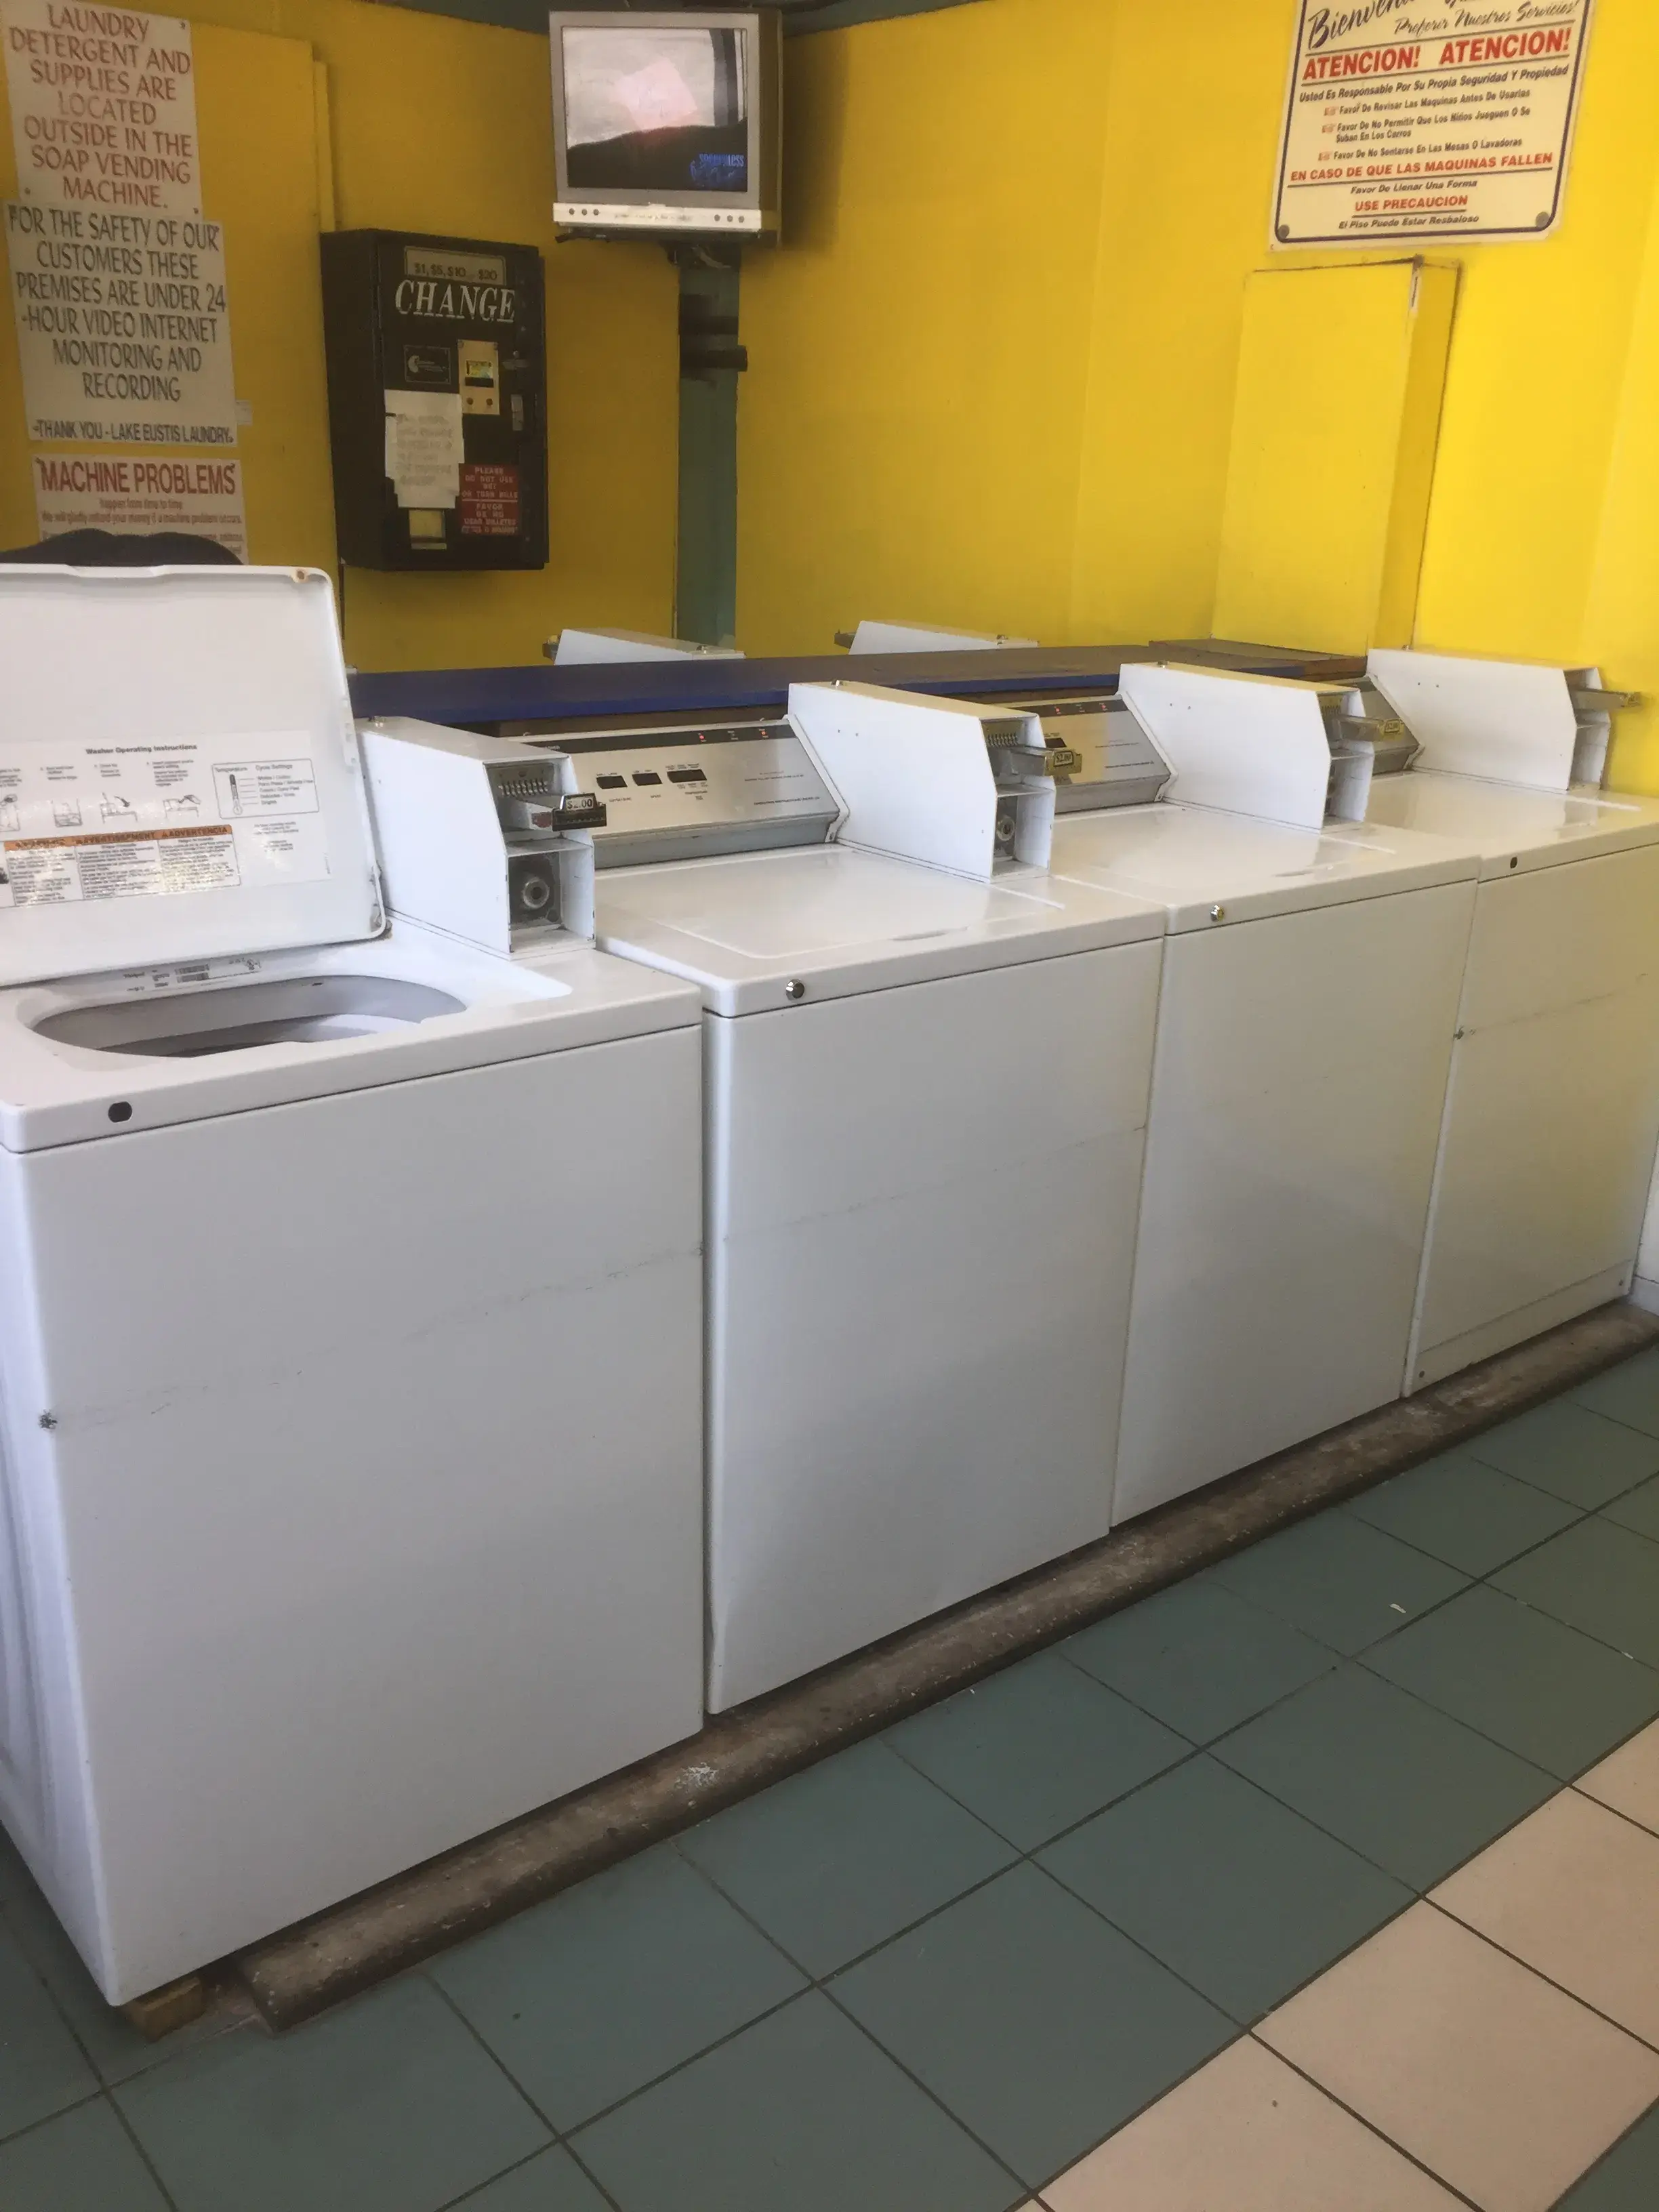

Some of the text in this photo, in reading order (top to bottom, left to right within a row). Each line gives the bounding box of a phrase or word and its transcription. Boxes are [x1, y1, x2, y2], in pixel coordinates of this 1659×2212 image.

[47, 4, 149, 42] LAUNDRY
[1455, 8, 1511, 27] Nuestros
[9, 26, 190, 75] DETERGENT AND
[1302, 27, 1572, 80] ATENCION! ATENCION!
[30, 59, 176, 100] SUPPLIES ARE
[1300, 64, 1569, 102] Usted Es Responsable Por Su Propia Seguridad Y Propiedad
[58, 90, 157, 125] LOCATED
[1337, 122, 1357, 131] Favor
[1359, 121, 1370, 130] De
[1372, 119, 1382, 129] No
[1384, 117, 1414, 127] Permitir
[1416, 115, 1431, 125] Que
[1434, 115, 1448, 123] Los
[1511, 107, 1518, 117] O
[1520, 106, 1531, 116] Se
[1339, 89, 1530, 115] Favor De Revisar Las Maquinas Antes De Usarlas
[24, 115, 192, 157] OUTSIDE IN THE
[1334, 138, 1522, 160] Favor De No Sentarse En Las Mesas O Lavadoras
[1336, 129, 1412, 144] Suban En Los Carros
[32, 144, 191, 184] SOAP VENDING
[1290, 152, 1553, 182] EN CASO DE QUE LAS MAQUINAS FALLEN
[63, 176, 168, 209] MACHINE.
[1350, 185, 1376, 194] Favor
[1378, 184, 1391, 192] De
[1425, 181, 1443, 190] Una
[1446, 180, 1478, 188] Forma
[1355, 194, 1468, 211] USE PRECAUCION
[7, 205, 220, 251] FOR THE SAFETY OF OUR
[1338, 215, 1479, 229] El Piso Puede Estar Resbaloso
[37, 241, 199, 280] CUSTOMERS THESE
[18, 272, 226, 313] PREMISES ARE UNDER 24
[395, 279, 515, 323] CHANGE
[83, 310, 136, 337] VIDEO
[141, 313, 218, 344] INTERNET
[53, 339, 201, 373] MONITORING AND
[83, 373, 181, 402] RECORDING
[81, 422, 102, 439] YOU
[143, 425, 181, 443] EUSTIS
[41, 461, 236, 495] MACHINE PROBLEMS
[567, 798, 592, 810] $2.00
